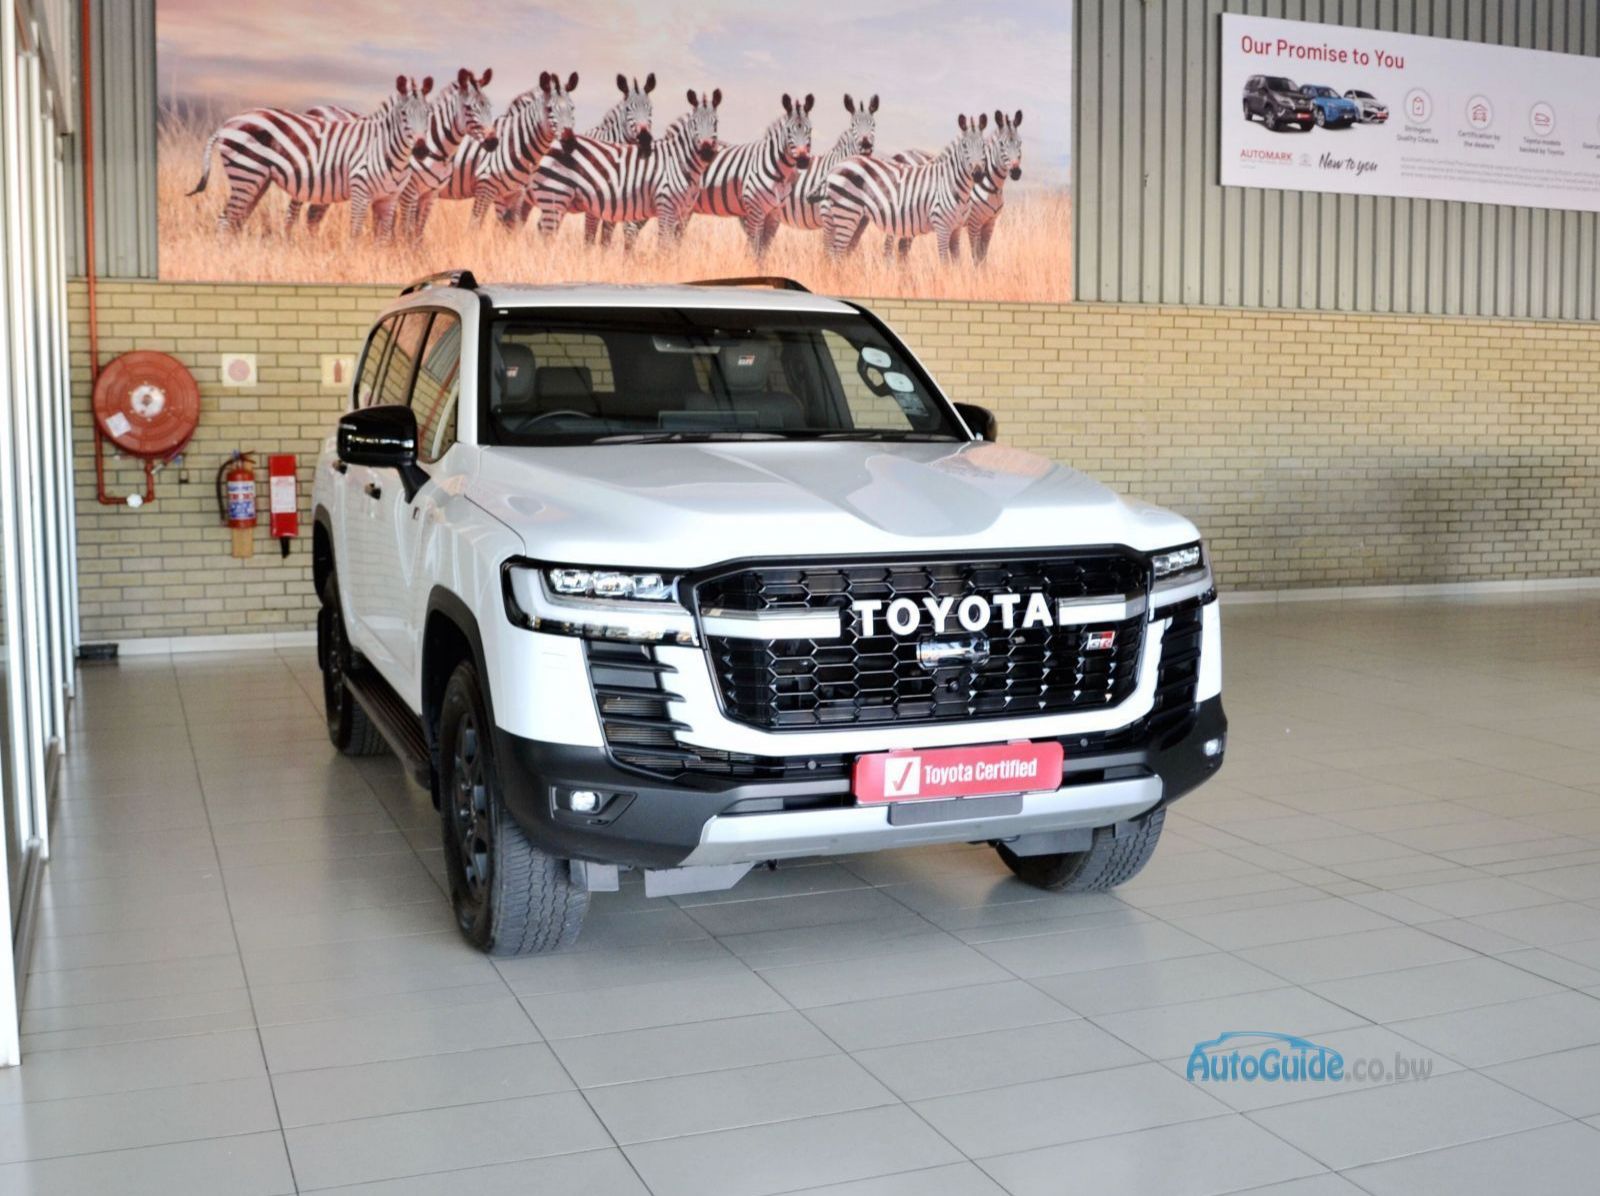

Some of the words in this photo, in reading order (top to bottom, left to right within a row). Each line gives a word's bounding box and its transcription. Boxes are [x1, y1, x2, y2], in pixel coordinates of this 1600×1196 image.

[1241, 35, 1272, 55] Our
[1276, 39, 1348, 63] Promise
[1353, 48, 1370, 66] to
[1375, 50, 1405, 69] You
[1240, 149, 1293, 161] AUTOMARK
[1319, 152, 1343, 170] New
[1356, 160, 1379, 176] you
[852, 592, 1053, 636] TOYOTA
[924, 762, 972, 785] Toyota
[975, 758, 1038, 781] Certified
